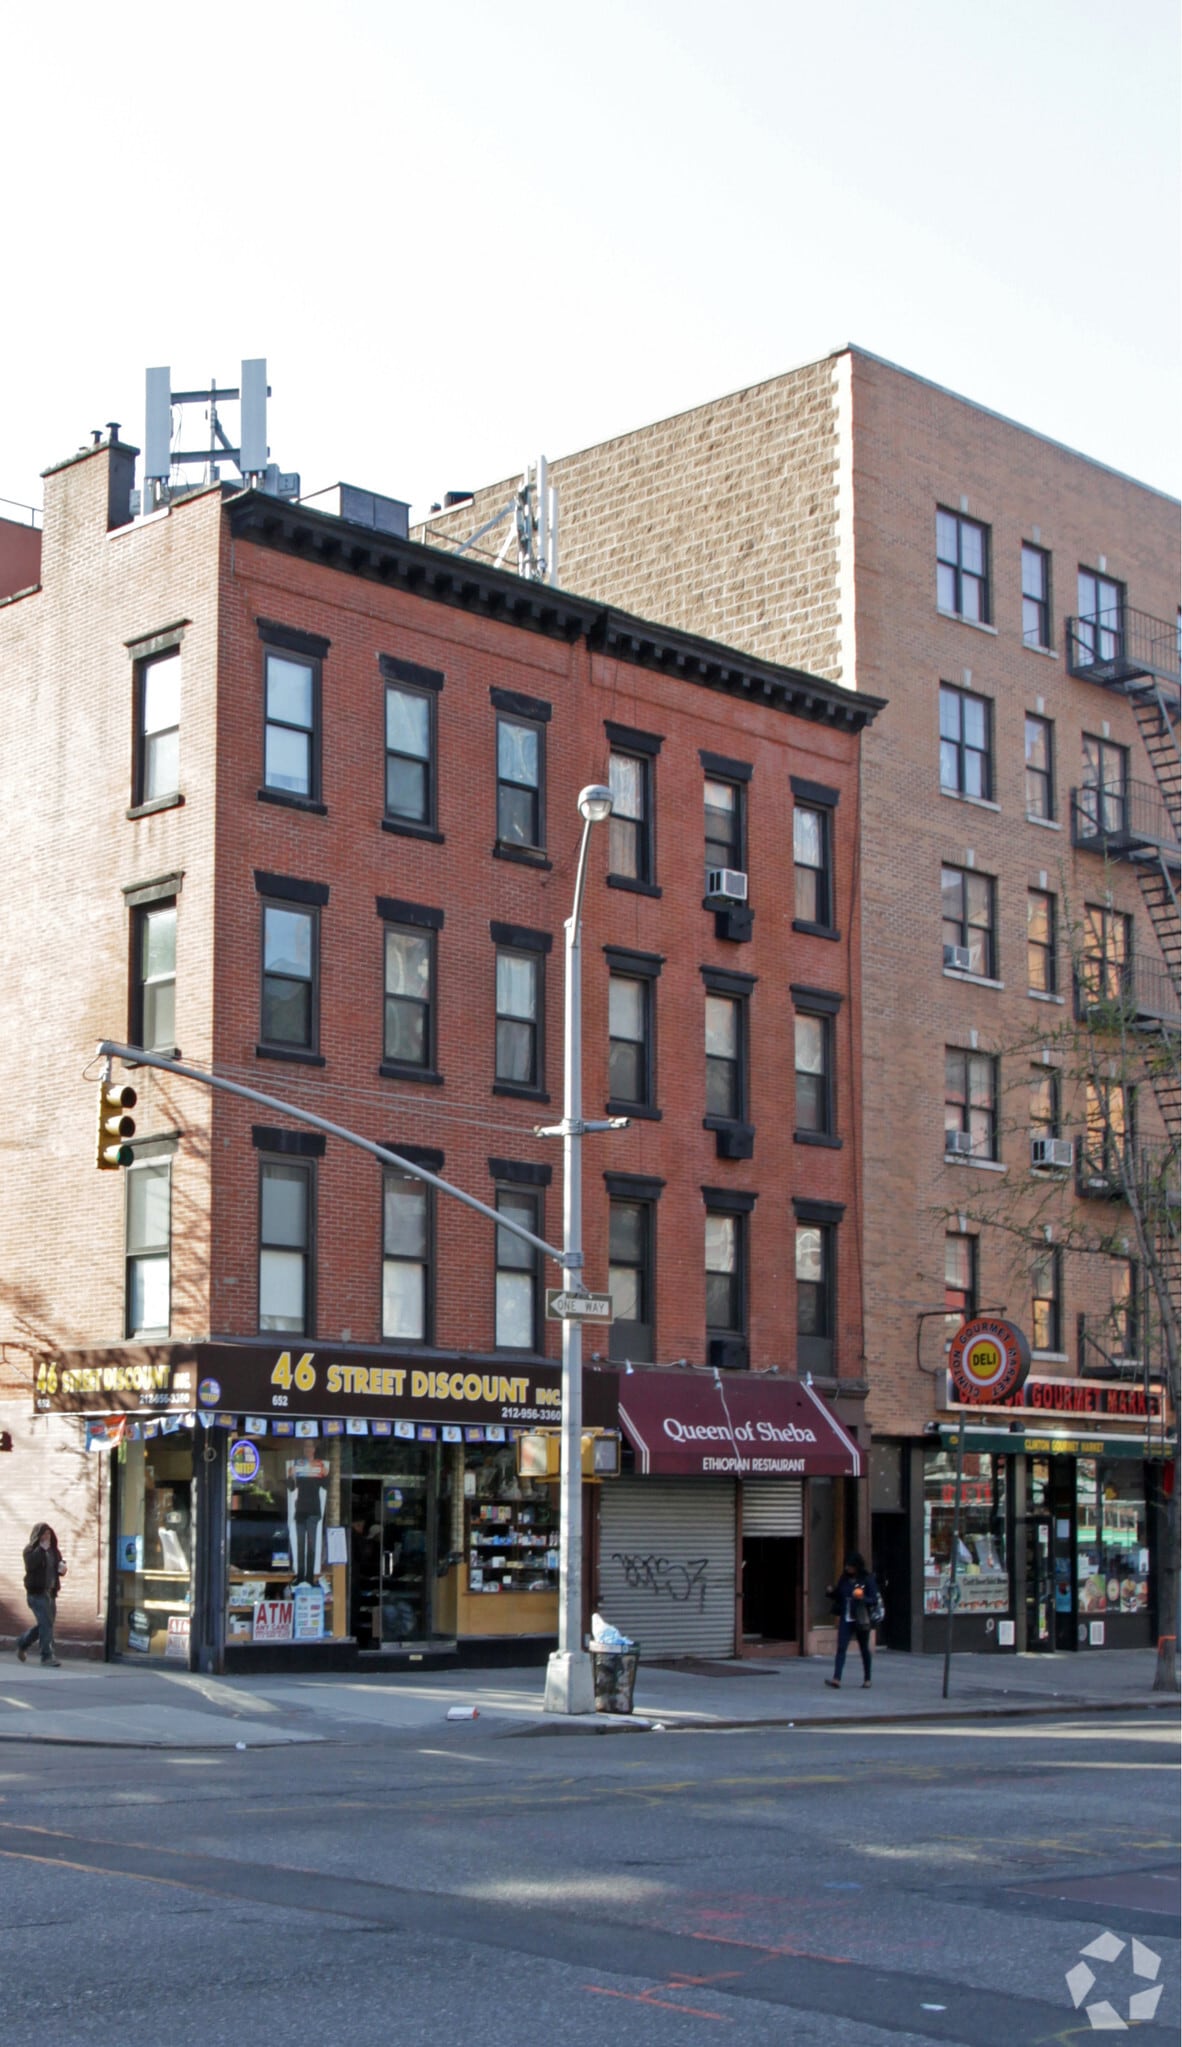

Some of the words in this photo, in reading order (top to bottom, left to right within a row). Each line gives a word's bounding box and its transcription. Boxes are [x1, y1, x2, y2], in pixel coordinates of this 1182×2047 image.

[557, 1300, 577, 1311] ONE
[585, 1301, 605, 1313] WAY
[959, 1322, 1010, 1344] GOURMET
[992, 1347, 1017, 1396] MARKET
[972, 1352, 997, 1367] DELI
[37, 1362, 58, 1394] 46
[62, 1368, 102, 1393] STREET
[103, 1365, 171, 1391] DISCOUNT
[271, 1351, 316, 1392] 46
[326, 1364, 407, 1396] STREET
[411, 1370, 529, 1402] DISCOUNT
[272, 1395, 288, 1406] 652
[1031, 1382, 1101, 1412] GOURMET
[501, 1407, 561, 1420] 212-956-3360
[663, 1418, 734, 1443] Queen
[734, 1421, 754, 1441] of
[756, 1422, 817, 1443] Sheba
[702, 1457, 750, 1471] ETHIOPIAN
[752, 1458, 806, 1472] RESTAURANT
[256, 1602, 292, 1625] ATM
